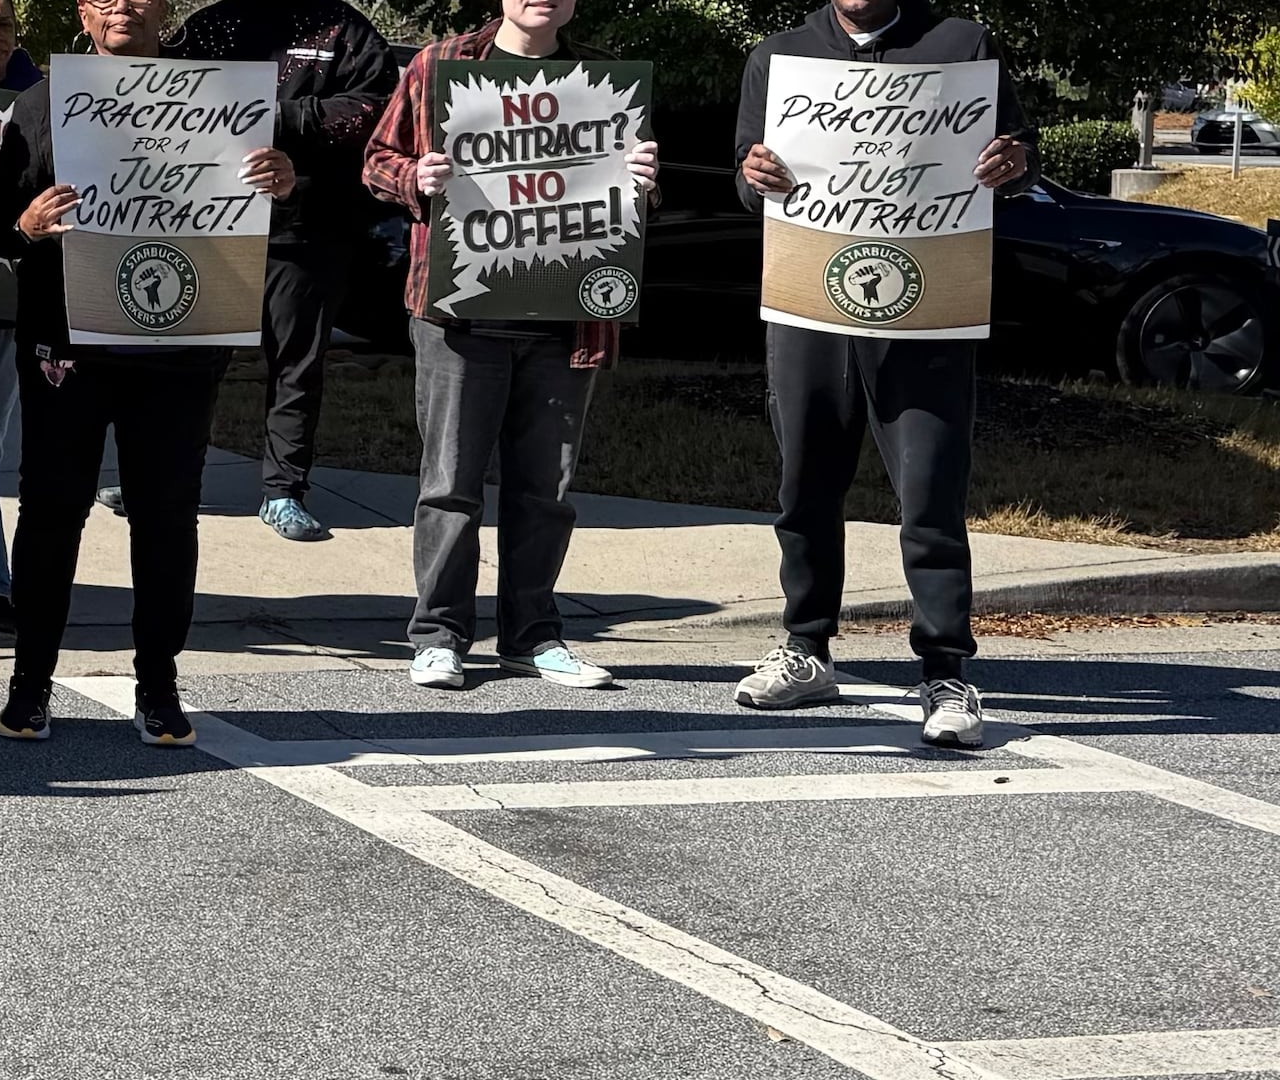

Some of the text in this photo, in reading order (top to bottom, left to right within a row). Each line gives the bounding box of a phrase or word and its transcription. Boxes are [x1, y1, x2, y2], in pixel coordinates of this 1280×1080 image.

[116, 63, 221, 98] JUST
[835, 69, 944, 102] JUST
[62, 92, 270, 136] PRACTICING
[501, 92, 559, 126] NO
[777, 95, 992, 136] PRACTICING
[131, 137, 190, 155] FOR A
[453, 112, 629, 167] CONTRACT?
[852, 142, 912, 158] FOR A
[110, 156, 220, 196] JUST
[508, 171, 566, 205] NO
[827, 161, 943, 196] JUST
[77, 184, 256, 233] CONTRACT!
[463, 187, 622, 253] COFFEE!
[783, 183, 978, 234] CONTRACT!
[125, 247, 188, 272] STARBUCKS
[840, 246, 910, 271] STARBUCKS
[120, 282, 194, 324] WORKERS UNITED
[829, 278, 919, 318] WORKERS UNITED
